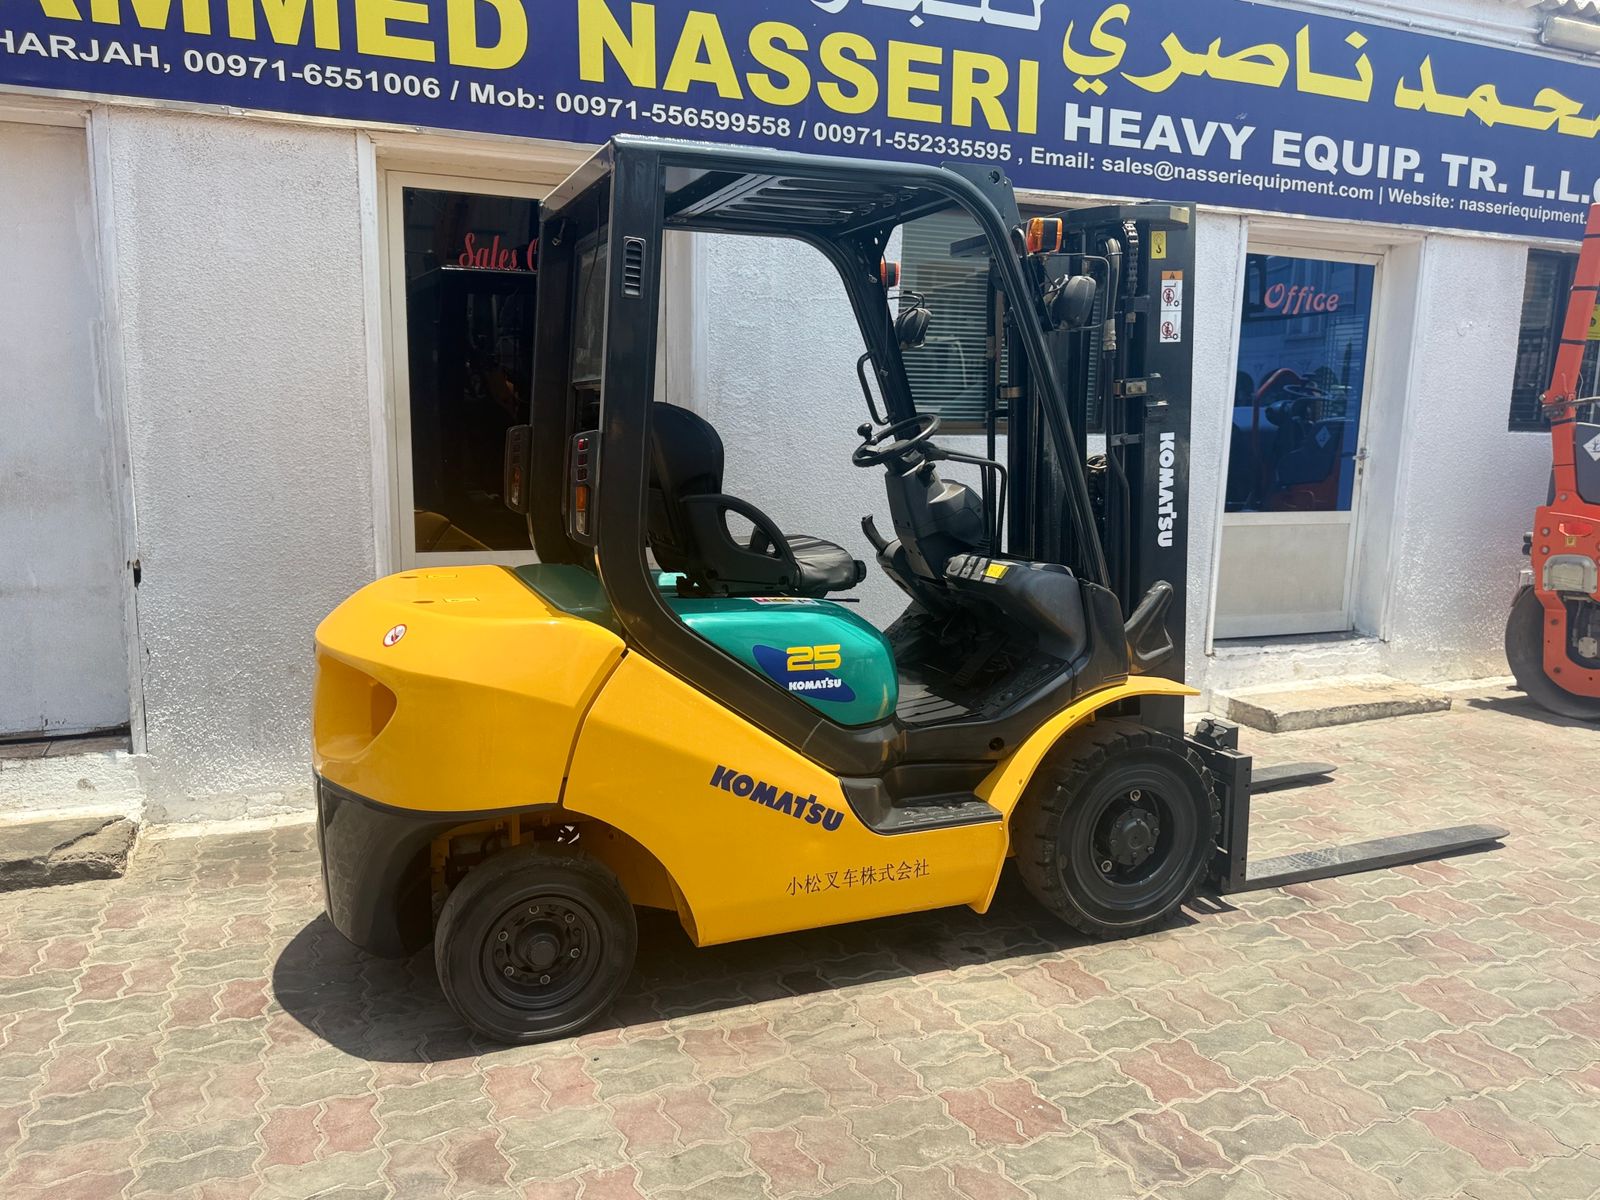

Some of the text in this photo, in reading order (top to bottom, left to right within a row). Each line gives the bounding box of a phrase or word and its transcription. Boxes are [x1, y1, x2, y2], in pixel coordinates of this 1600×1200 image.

[577, 0, 1039, 135] NASSERI
[1062, 3, 1375, 103] ناصري
[184, 49, 441, 99] 00971-6551006
[470, 81, 546, 110] Mob:
[555, 92, 791, 138] 00971-556599558
[813, 122, 1012, 161] 00971-552335595
[1030, 145, 1095, 170] Email:
[1102, 156, 1374, 201] sales@nasseriequipment.com
[1388, 187, 1455, 209] Website:
[1063, 102, 1256, 161] HEAVY
[1271, 130, 1425, 184] EQUIP.
[1441, 152, 1508, 194] TR.
[458, 232, 519, 271] Sales
[1263, 283, 1340, 315] Office
[1157, 431, 1178, 547] KOMATSU
[786, 643, 842, 672] 25
[788, 677, 842, 691] KOMATSU
[709, 764, 845, 832] KOMATSU
[785, 858, 931, 897] 小松叉车株式会社
